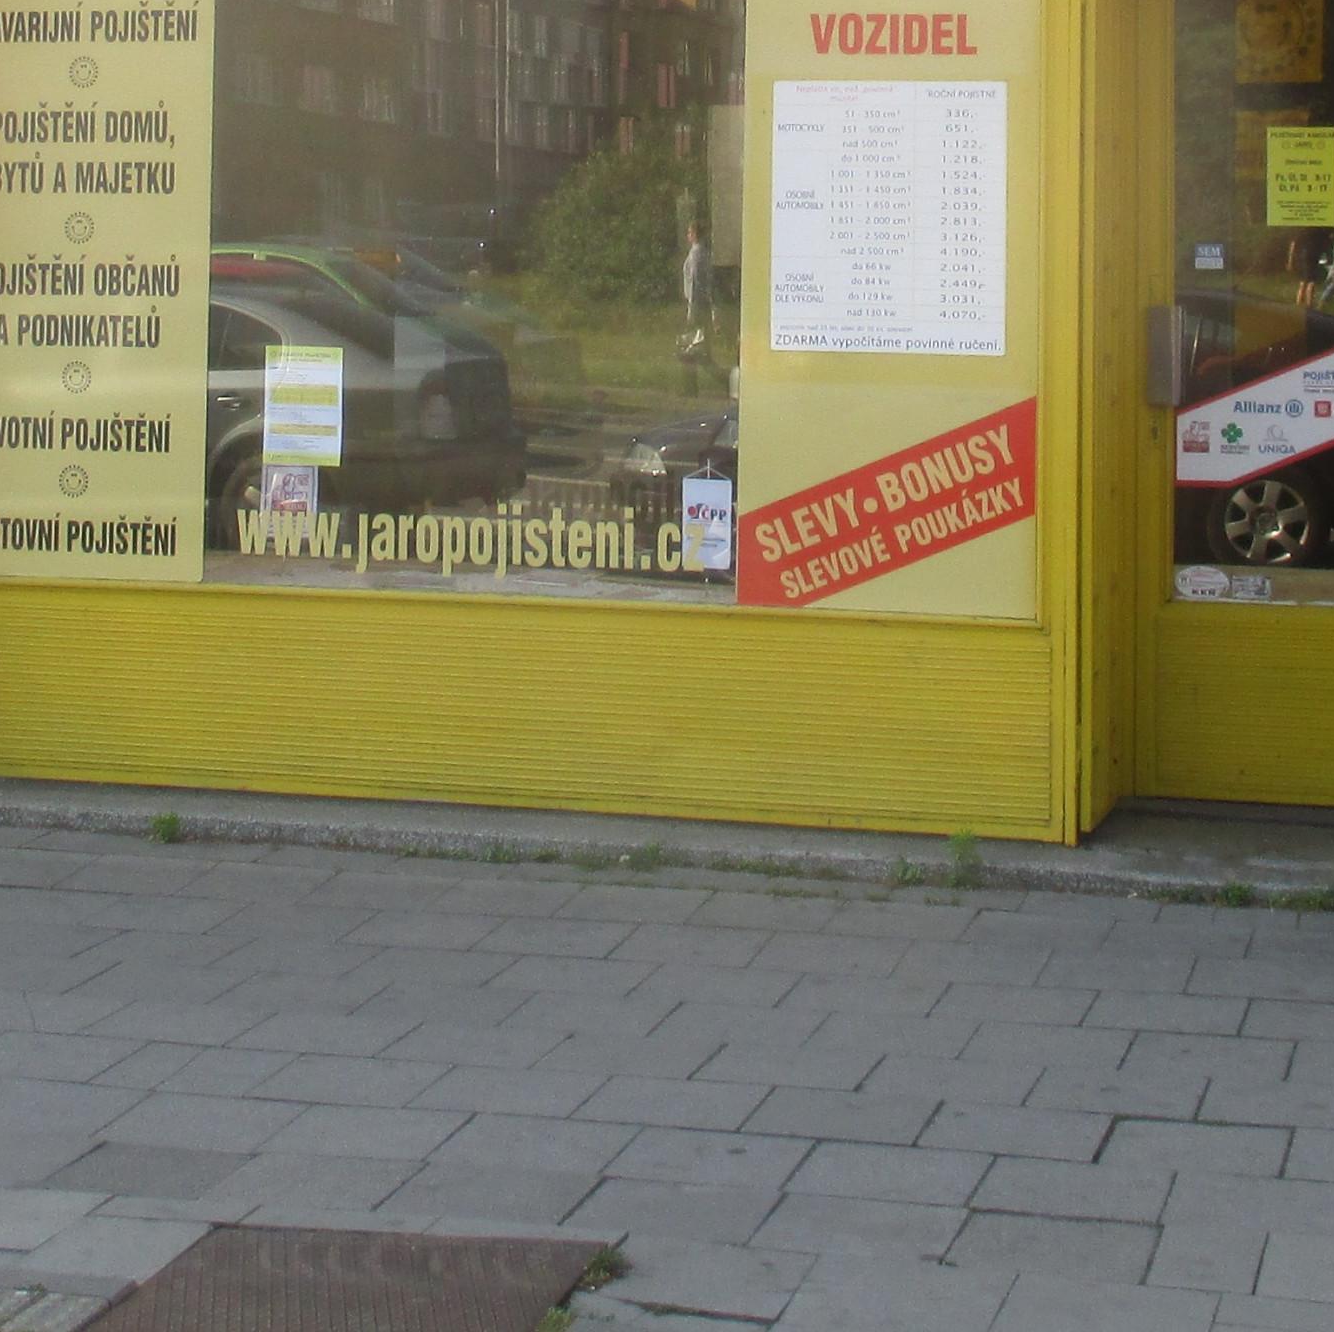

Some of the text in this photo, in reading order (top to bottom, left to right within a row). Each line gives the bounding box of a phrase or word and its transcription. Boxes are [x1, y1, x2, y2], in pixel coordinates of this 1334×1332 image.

[90, 0, 199, 42] POJIŠTĚNÍ
[810, 13, 978, 56] VOZIDEL
[104, 100, 175, 149] DOMŮ,
[52, 162, 67, 194] A
[74, 162, 176, 195] MAJETKU
[93, 254, 180, 297] OBČANŮ
[17, 305, 161, 348] PODNIKATELŮ
[775, 335, 828, 346] ZDARMA
[831, 336, 902, 350] vypočítáme
[905, 337, 955, 351] povinné
[1233, 400, 1282, 415] Allianz
[60, 412, 172, 453] POJIŠTĚNÍ
[1258, 444, 1296, 455] UNIQA
[66, 515, 178, 557] POJIŠTĚNÍ
[237, 503, 705, 579] www.jaropojisteni.cz
[779, 477, 1026, 600] SLEVOVÉ POUKÁZKY
